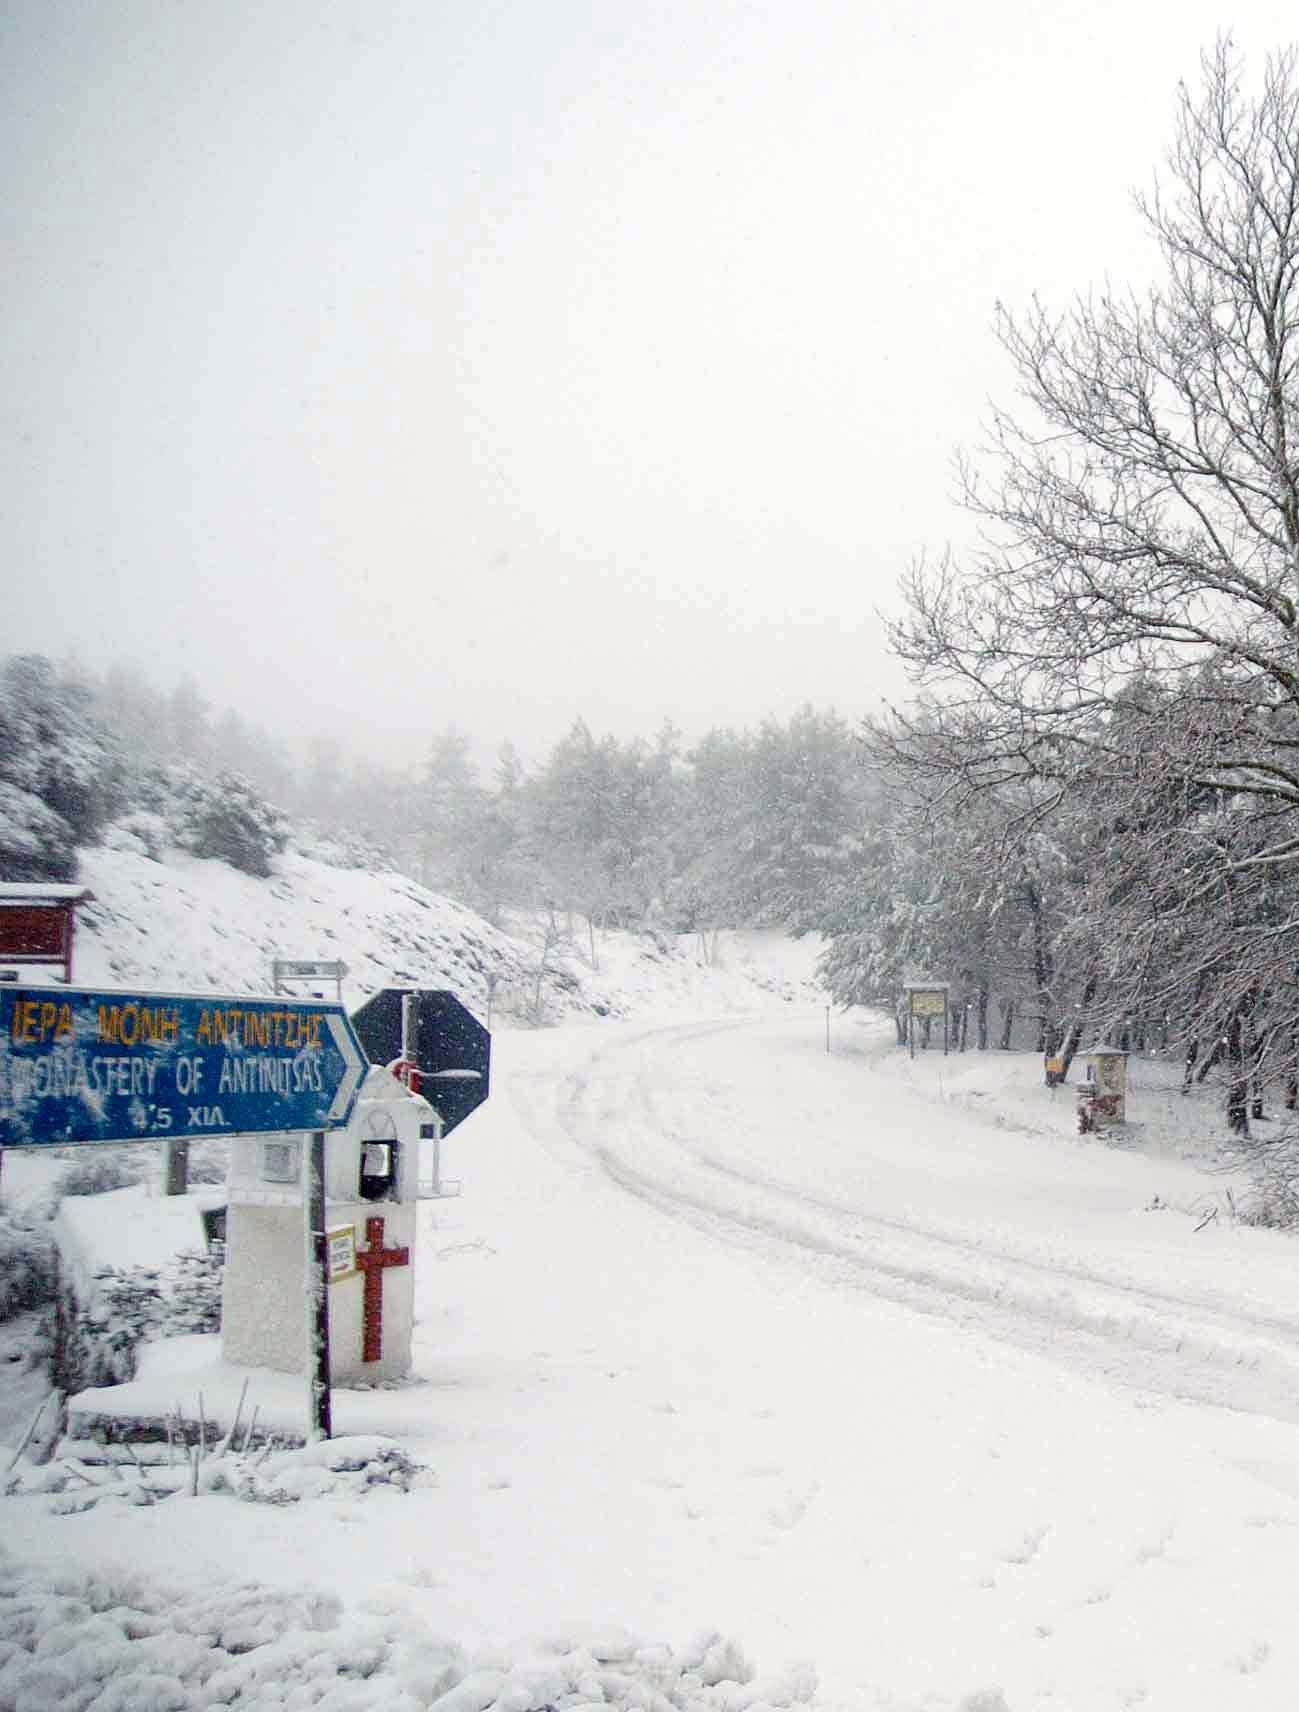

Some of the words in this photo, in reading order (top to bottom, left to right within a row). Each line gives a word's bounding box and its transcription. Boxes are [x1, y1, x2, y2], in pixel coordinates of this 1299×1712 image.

[12, 1001, 73, 1041] ΙΕΡΑ
[97, 1006, 178, 1044] ΜΟΝΗ
[176, 1057, 203, 1095] OF
[219, 1056, 322, 1094] ANTINITSAS
